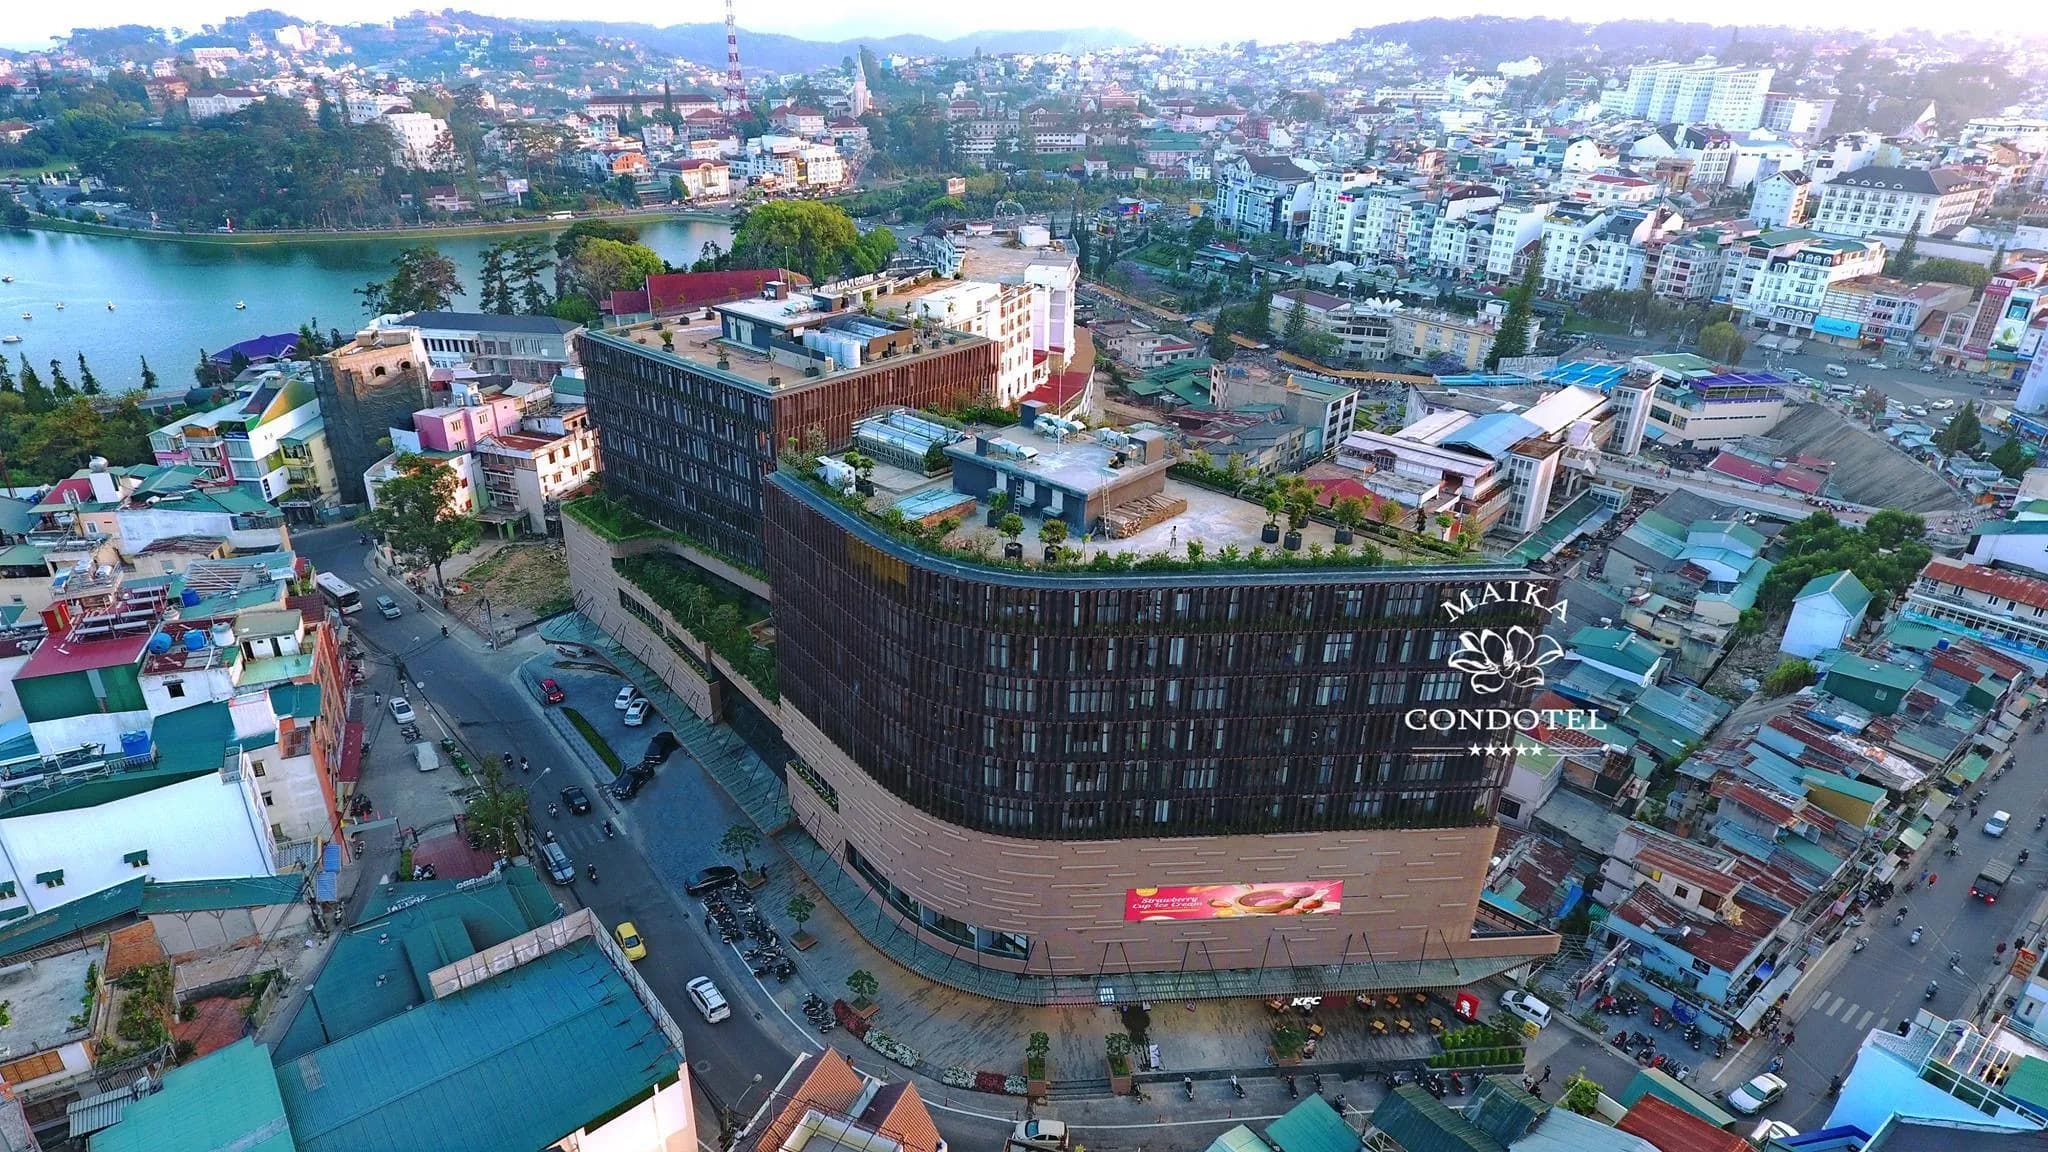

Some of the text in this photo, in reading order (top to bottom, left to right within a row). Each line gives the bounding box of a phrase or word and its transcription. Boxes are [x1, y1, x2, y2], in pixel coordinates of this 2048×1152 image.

[1132, 902, 1152, 910] Cup
[1171, 900, 1203, 909] Cream
[1141, 896, 1199, 905] Strawberry
[1291, 996, 1322, 1007] KFC
